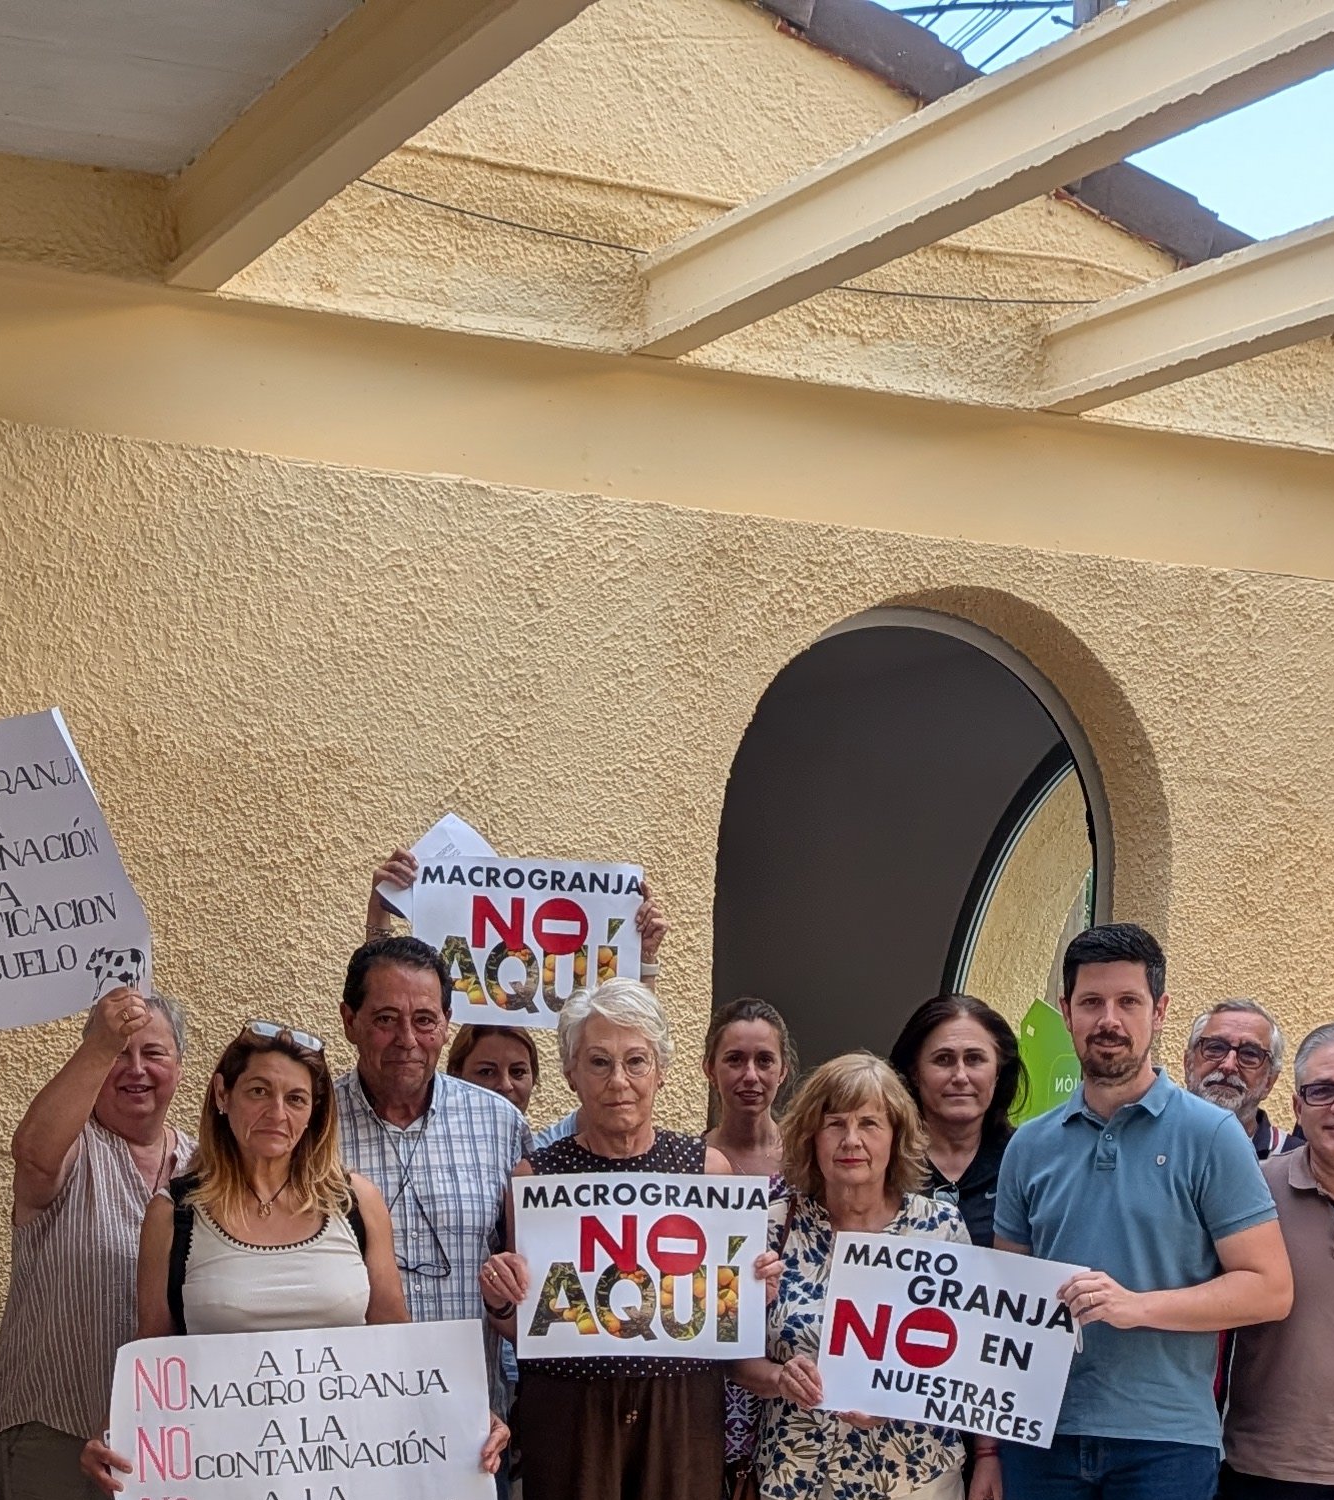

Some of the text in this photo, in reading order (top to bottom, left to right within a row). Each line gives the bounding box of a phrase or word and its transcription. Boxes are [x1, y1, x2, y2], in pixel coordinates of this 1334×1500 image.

[421, 865, 642, 896] MACROGRANJA
[472, 895, 589, 955] NO
[441, 918, 625, 1013] AQUÍ
[523, 1183, 768, 1210] MACROGRANJA
[580, 1214, 707, 1276] NO
[843, 1243, 958, 1276] MACRO
[528, 1236, 747, 1343] AQUÍ
[907, 1276, 1075, 1334] GRANJA
[255, 1347, 342, 1377] A LA
[829, 1298, 1033, 1371] NO EN
[135, 1357, 449, 1412] NO MACRO GRANJA
[872, 1368, 1017, 1412] NUESTRAS
[258, 1416, 347, 1447] A LA
[924, 1398, 1043, 1442] NARICES
[137, 1426, 447, 1483] NO CONTAMINACIÓN
